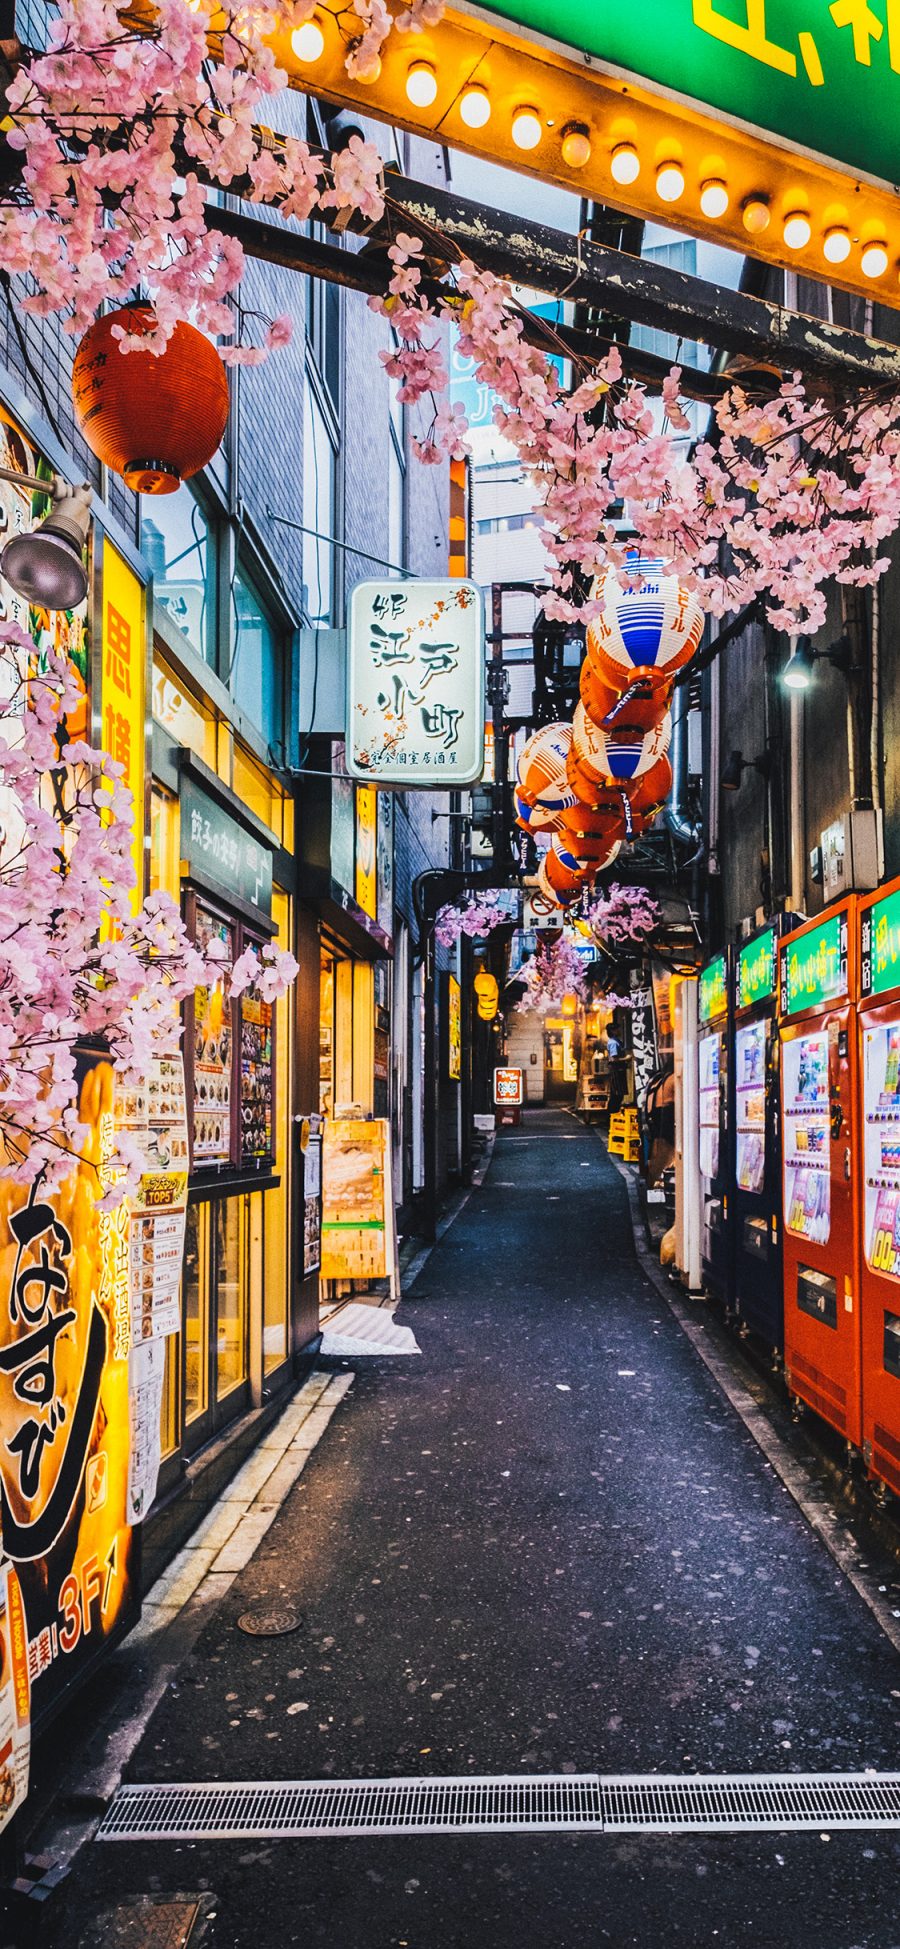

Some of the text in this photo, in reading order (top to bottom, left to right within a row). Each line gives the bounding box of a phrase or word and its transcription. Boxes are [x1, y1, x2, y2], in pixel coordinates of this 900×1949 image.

[622, 584, 659, 596] Aahi
[530, 918, 558, 926] 禁煙
[862, 920, 871, 990] 新宿
[149, 1190, 170, 1204] TOP5
[116, 1166, 129, 1358] ひ出酒場
[59, 1554, 99, 1653] 3F
